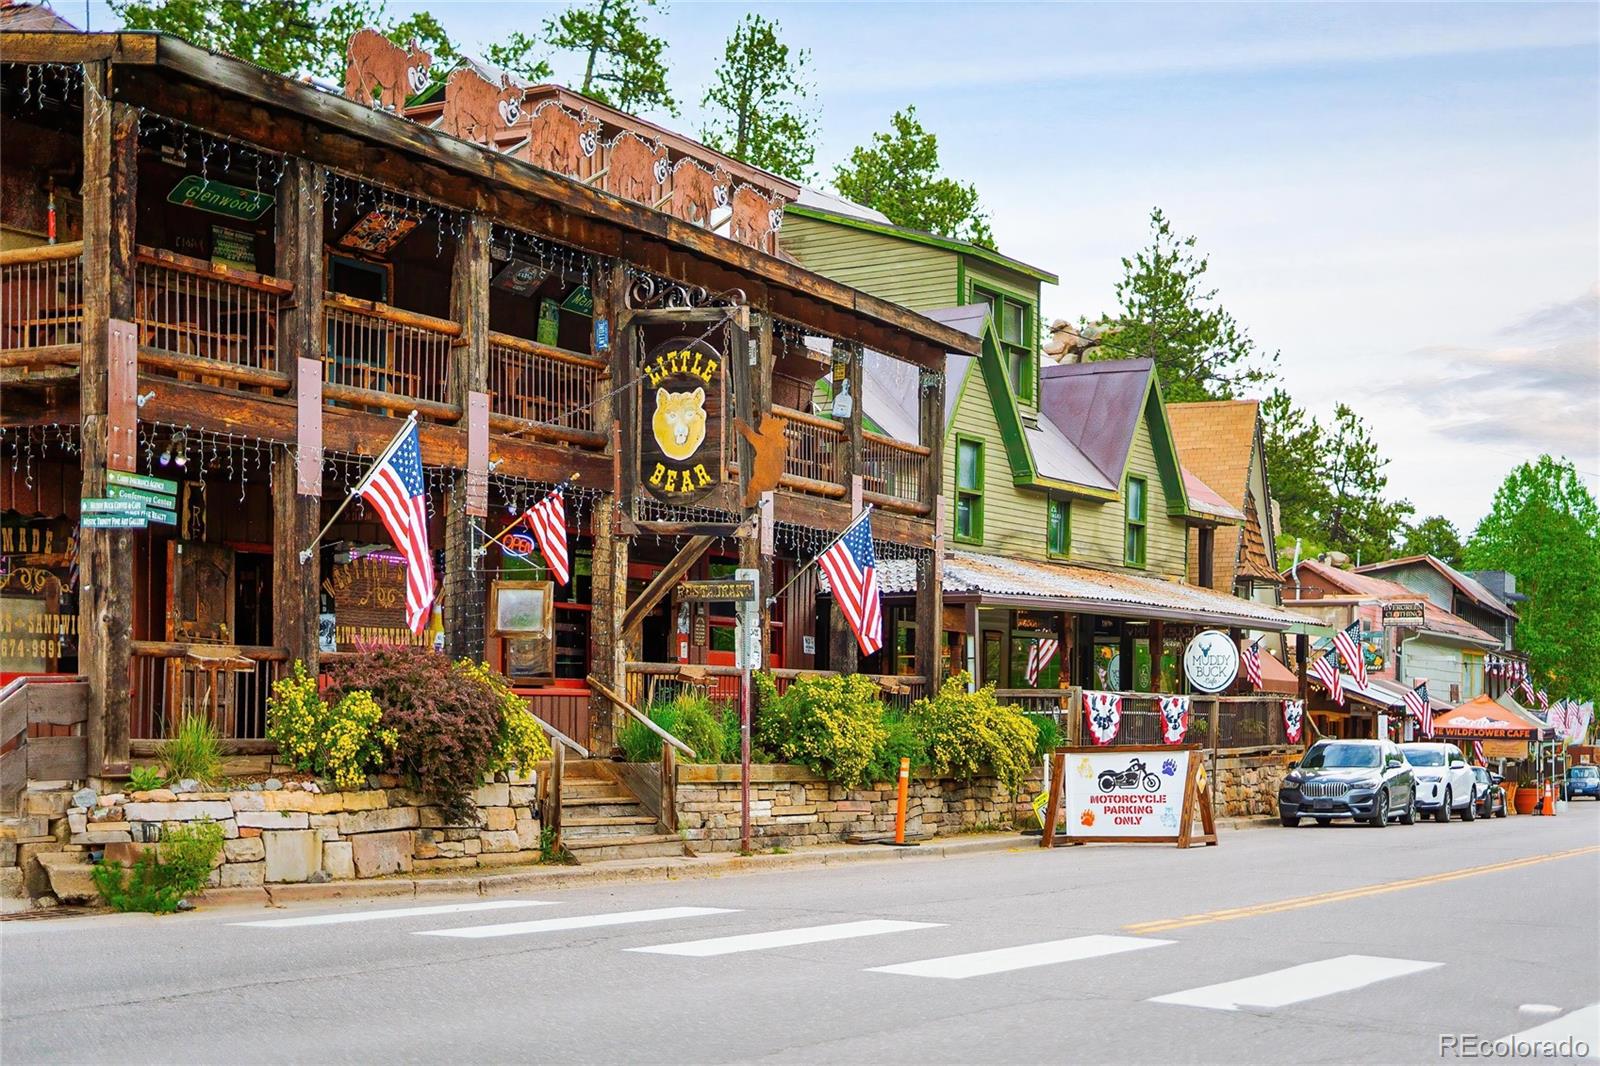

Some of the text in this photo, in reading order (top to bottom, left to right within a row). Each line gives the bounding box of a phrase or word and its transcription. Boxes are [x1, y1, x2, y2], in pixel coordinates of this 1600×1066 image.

[185, 186, 257, 213] Glenwood
[644, 350, 718, 385] LITTLE
[649, 462, 711, 493] BEAR
[153, 495, 172, 506] Center
[503, 534, 533, 554] OPEN
[677, 583, 753, 599] RESTAURANT
[1192, 655, 1231, 666] MUDDY
[1196, 666, 1227, 677] BUCK
[1446, 729, 1506, 738] WILDFLOWER
[1090, 794, 1167, 804] MOTORCYCLE
[1103, 805, 1154, 815] PARKING
[1114, 816, 1143, 826] ONLY
